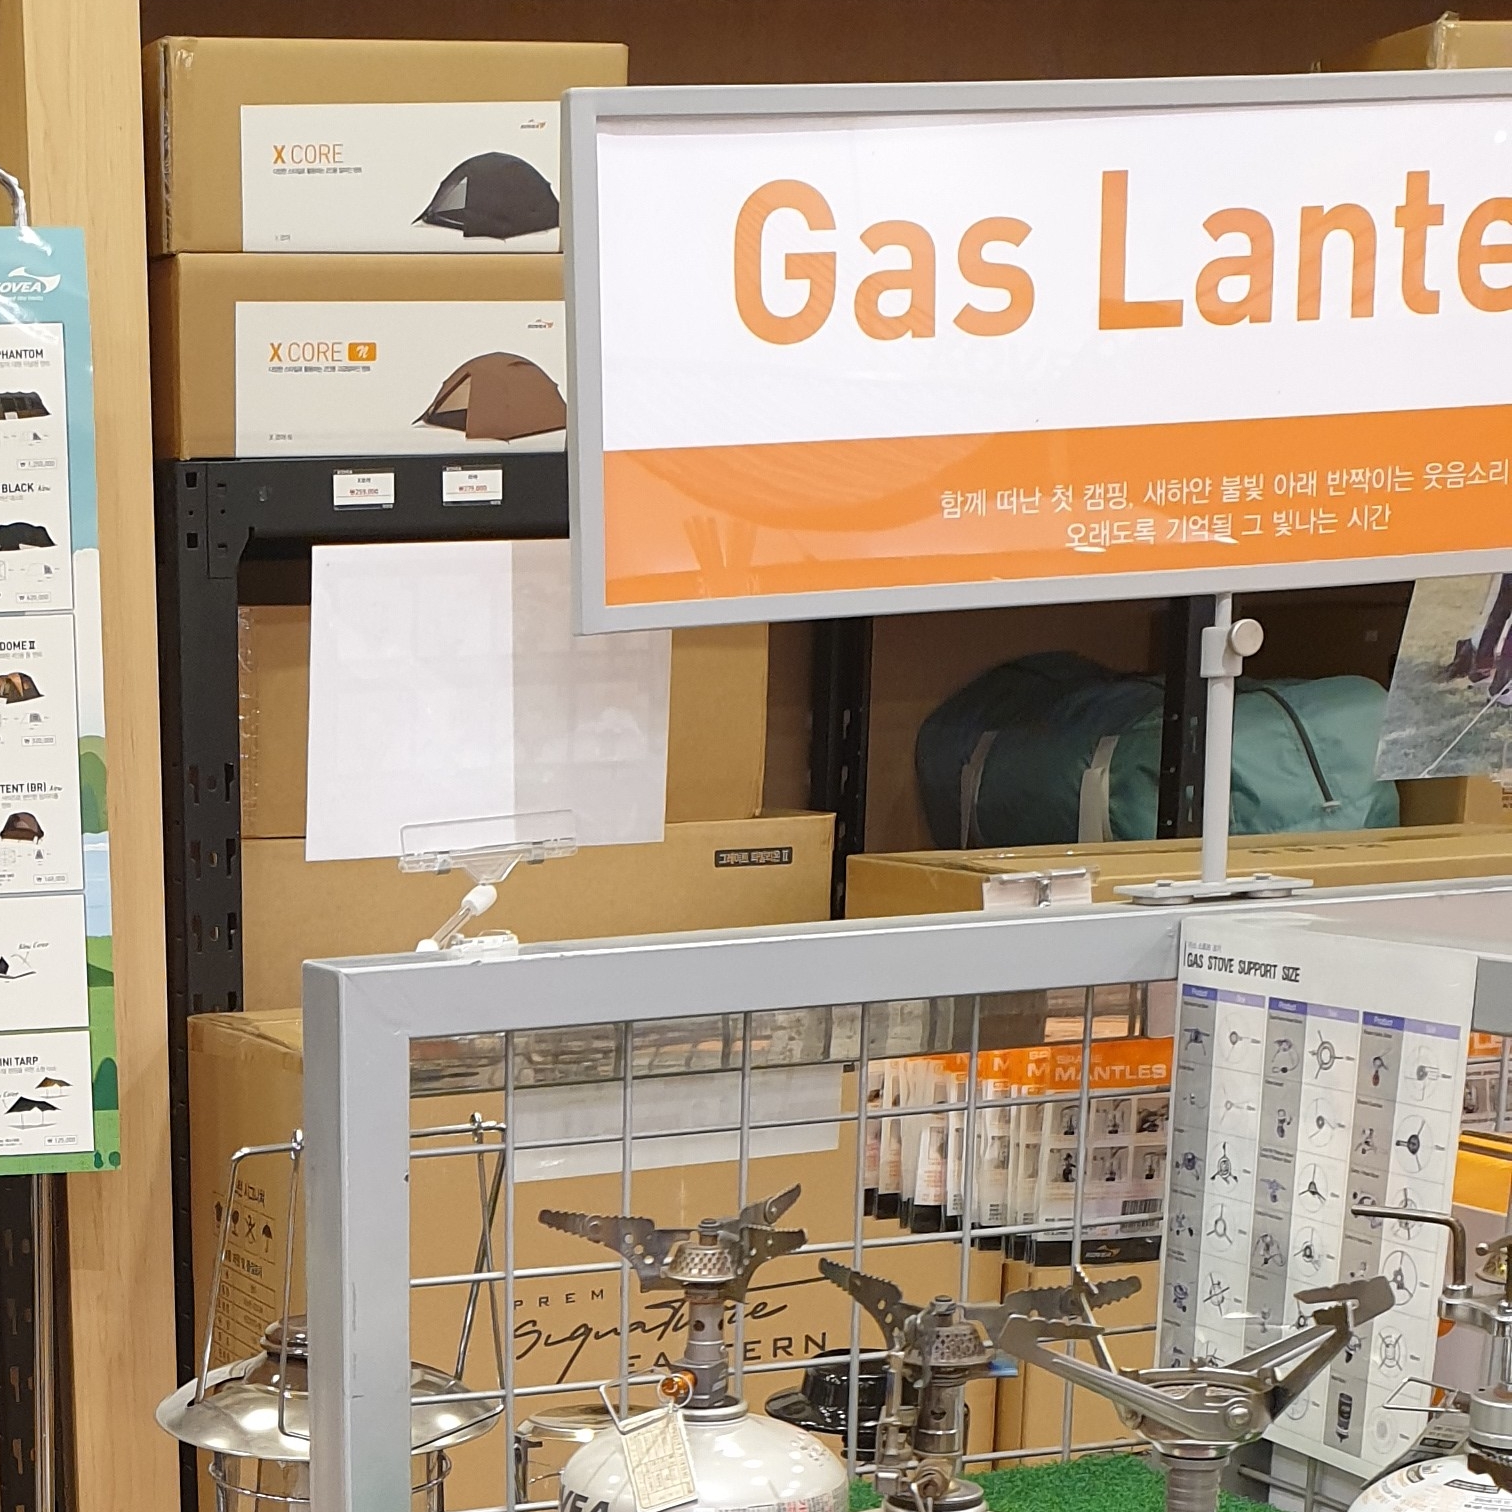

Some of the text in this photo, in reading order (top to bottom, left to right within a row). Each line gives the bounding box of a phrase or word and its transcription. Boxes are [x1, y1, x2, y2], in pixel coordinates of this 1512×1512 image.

[273, 143, 344, 165] X CORE
[734, 177, 1036, 347] Gas
[269, 341, 343, 363] X CORE
[1, 482, 35, 494] BLACK
[939, 457, 1511, 520] 함께 떠난 첫 캠핑, 새하얀 불빛 아래 반짝이는 웃음소리
[1065, 503, 1391, 549] 오래도록 기억될 그 빛나는 시간
[0, 640, 28, 652] DOME
[0, 783, 25, 794] TENT
[26, 781, 48, 794] (BR)
[1186, 952, 1301, 983] GAS STOVE SUPPORT SIZE
[14, 1056, 39, 1067] TARP
[1054, 1062, 1168, 1083] MANTLES
